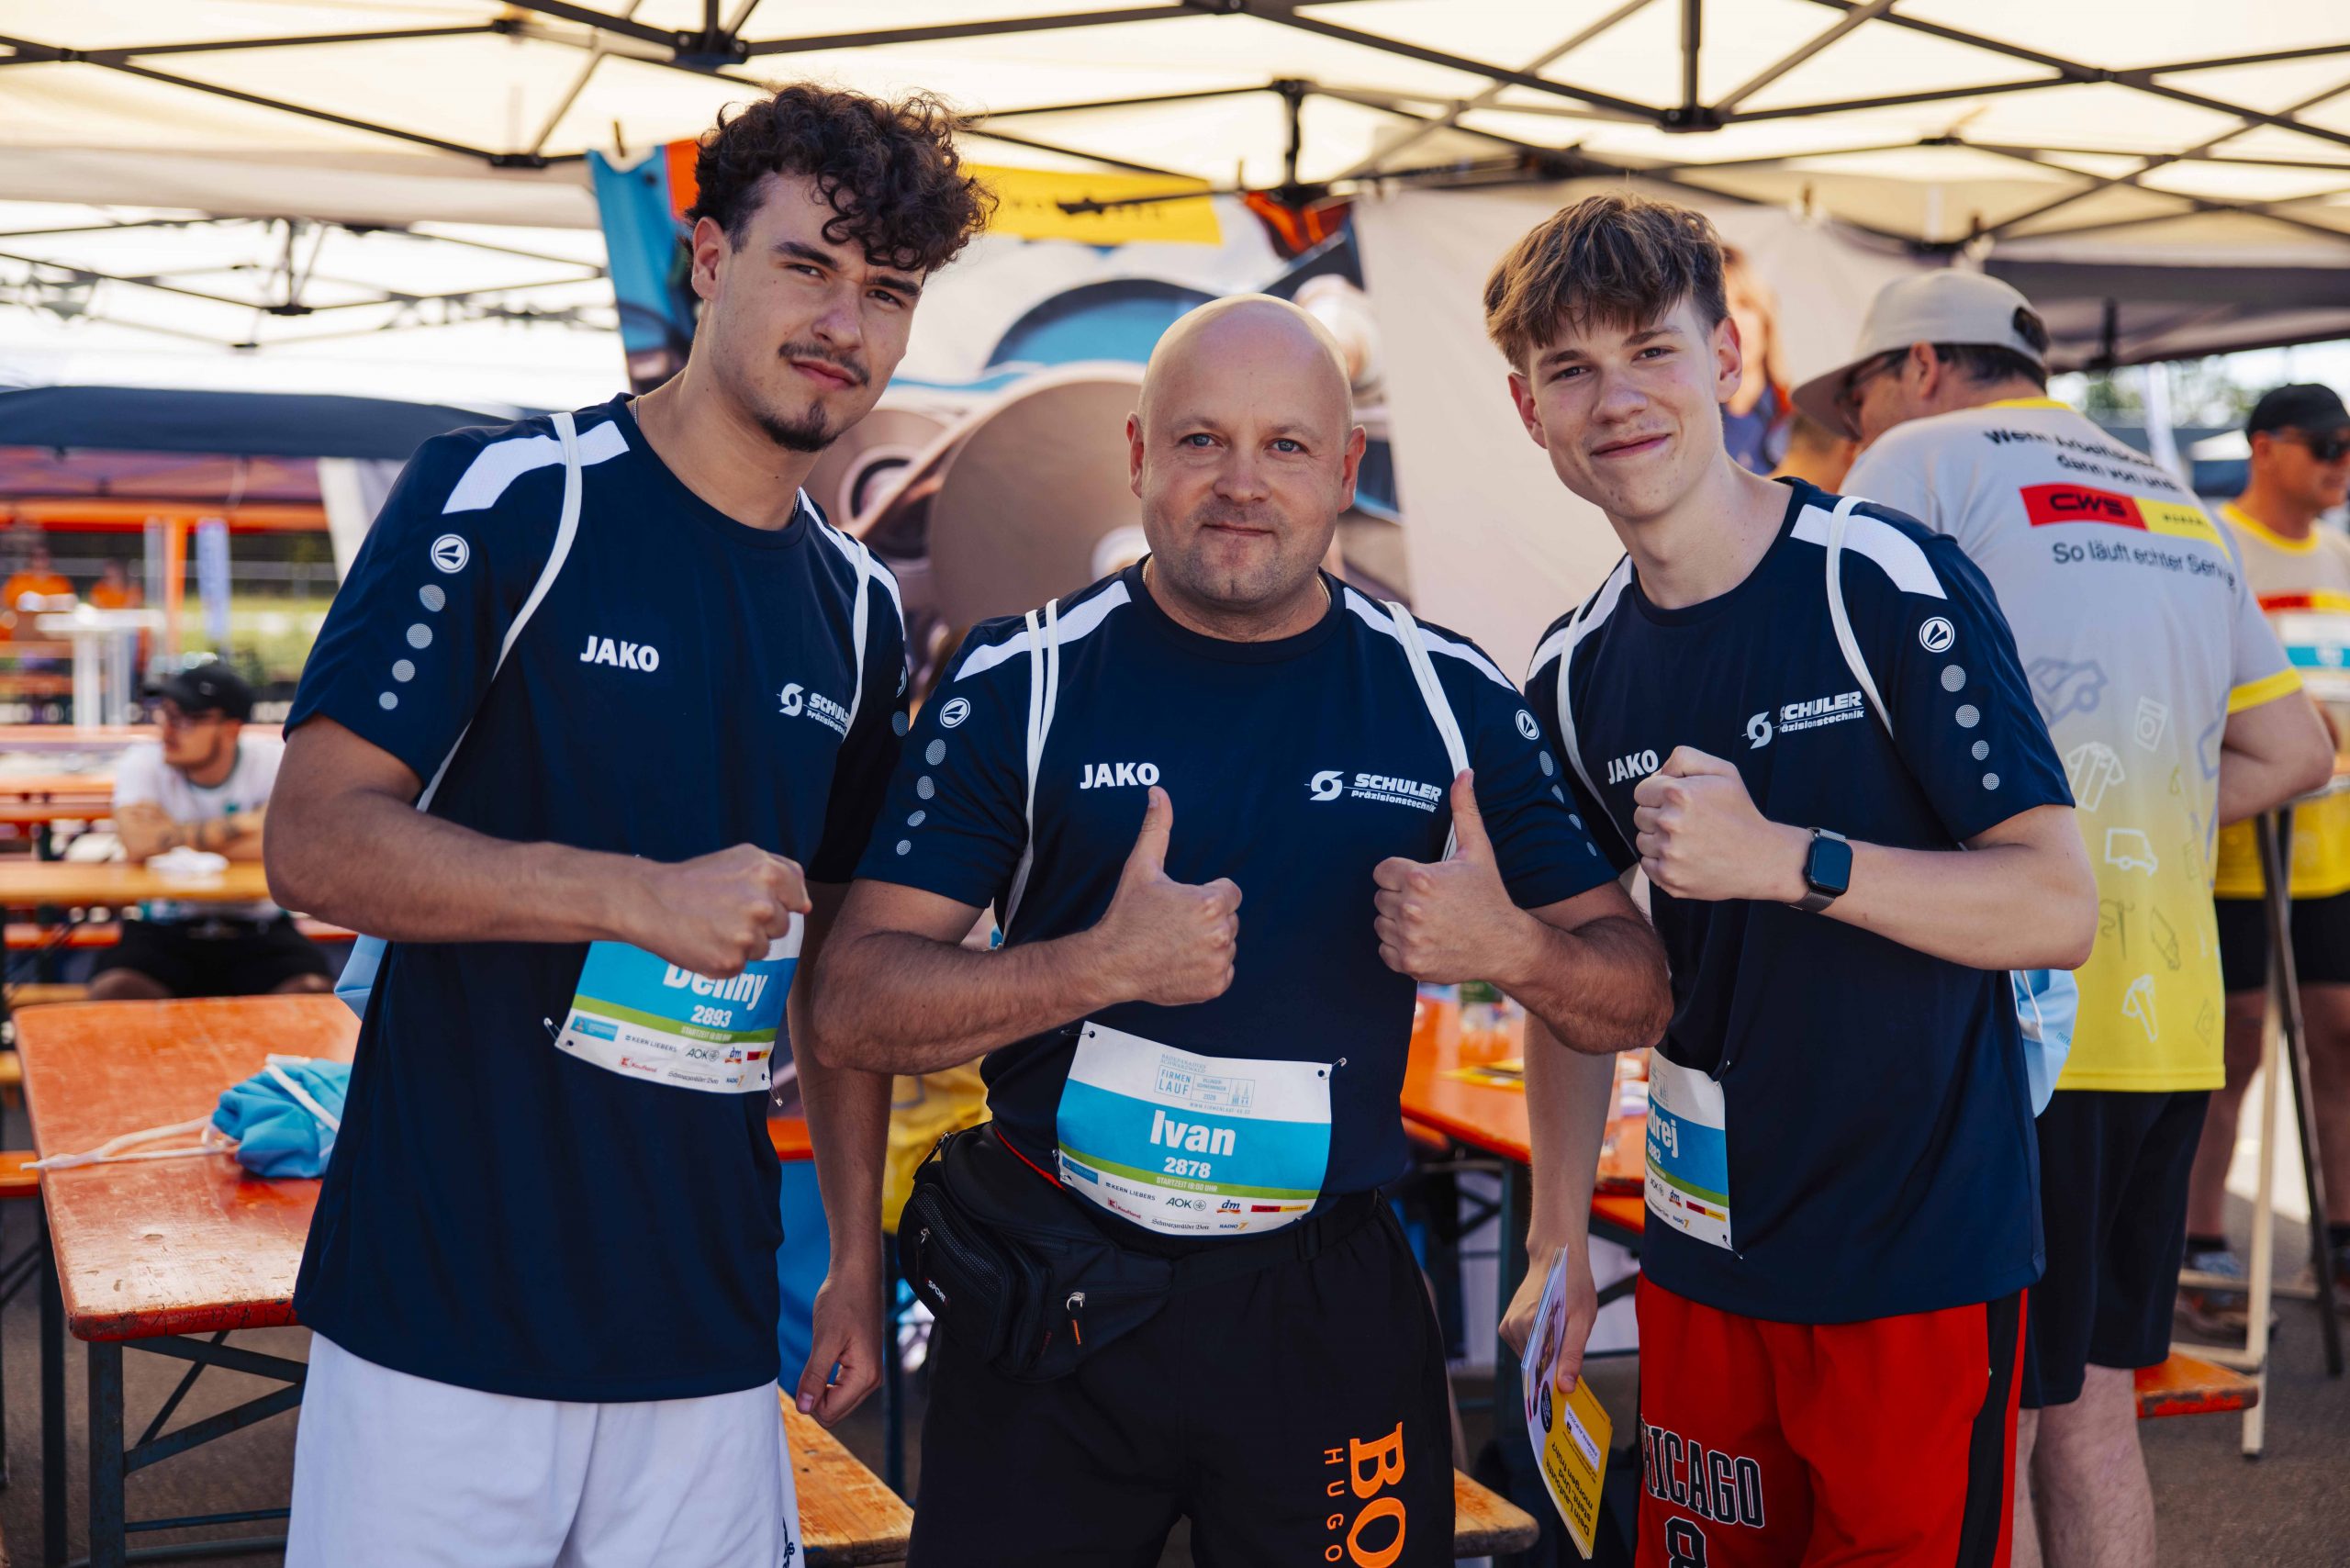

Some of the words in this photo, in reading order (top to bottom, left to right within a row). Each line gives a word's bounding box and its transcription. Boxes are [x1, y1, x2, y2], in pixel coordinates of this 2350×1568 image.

[2049, 493, 2127, 518] CWS
[2053, 543, 2085, 565] So
[2088, 540, 2130, 562] läuft
[580, 635, 660, 673] JAKO
[1779, 710, 1864, 734] äzisionstechnik
[1080, 762, 1160, 789] JAKO
[1607, 749, 1659, 785] JAKO
[1354, 773, 1442, 802] SCHULER
[690, 1004, 733, 1028] 2893
[686, 1048, 709, 1059] AOK
[1158, 1079, 1189, 1095] LAUF
[1160, 1070, 1192, 1083] FIRMEN
[1149, 1109, 1237, 1157] Ivan
[1648, 1103, 1679, 1159] drej
[1163, 1156, 1212, 1180] 2878
[1111, 1184, 1128, 1194] KERN
[1129, 1190, 1156, 1202] LIEBERS
[1156, 1176, 1187, 1189] STARTZEIT
[1204, 1183, 1218, 1193] UHR
[1166, 1197, 1192, 1209] AOK
[1221, 1199, 1240, 1210] dm
[1640, 1416, 1765, 1529] HICAGO
[1324, 1448, 1345, 1562] HUGO
